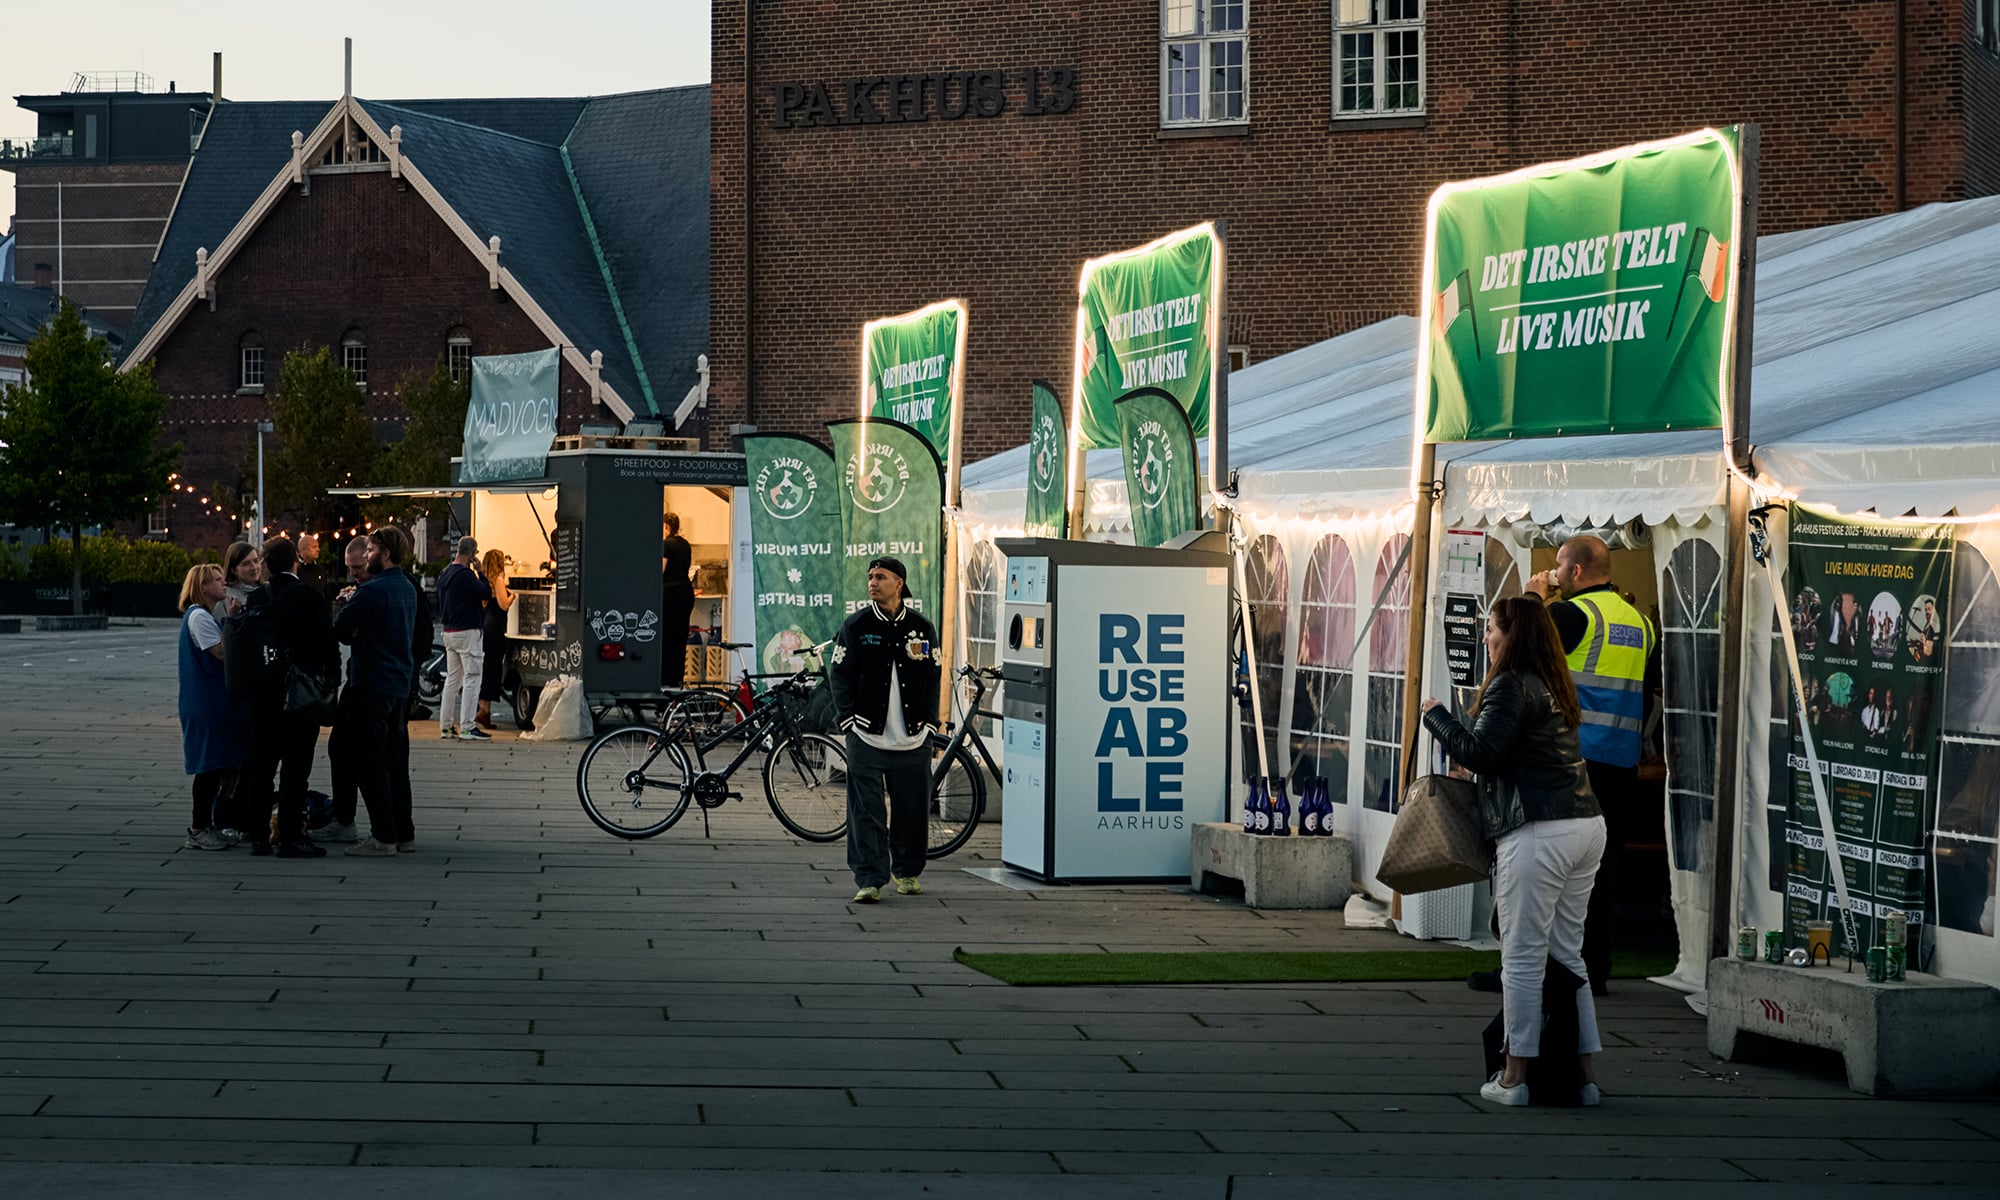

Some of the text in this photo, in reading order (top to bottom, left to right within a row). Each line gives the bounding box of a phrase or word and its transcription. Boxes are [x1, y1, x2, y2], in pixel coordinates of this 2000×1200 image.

[771, 66, 1076, 129] PAKHUS 13
[1479, 221, 1687, 292] DET IRSKE TELT
[1108, 293, 1201, 342] DET IRSKE TELT
[1496, 299, 1650, 355] LIVE MUSIK
[1121, 349, 1188, 390] LIVE MUSIK
[892, 402, 910, 424] LIVE
[614, 458, 671, 469] STREETFOOD
[679, 459, 739, 471] FOODTRUCKS
[1818, 524, 1844, 536] FESTUGE
[1844, 525, 1859, 537] 2025
[1825, 561, 1914, 580] LIVE MUSIK HVER DAG
[1099, 613, 1185, 664] RE
[1610, 624, 1642, 641] SECURITY
[1099, 669, 1185, 702] USE
[1095, 707, 1189, 757] AB
[1097, 762, 1184, 812] LE
[1833, 764, 1856, 777] LØRDAG
[1097, 815, 1184, 830] AARHUS
